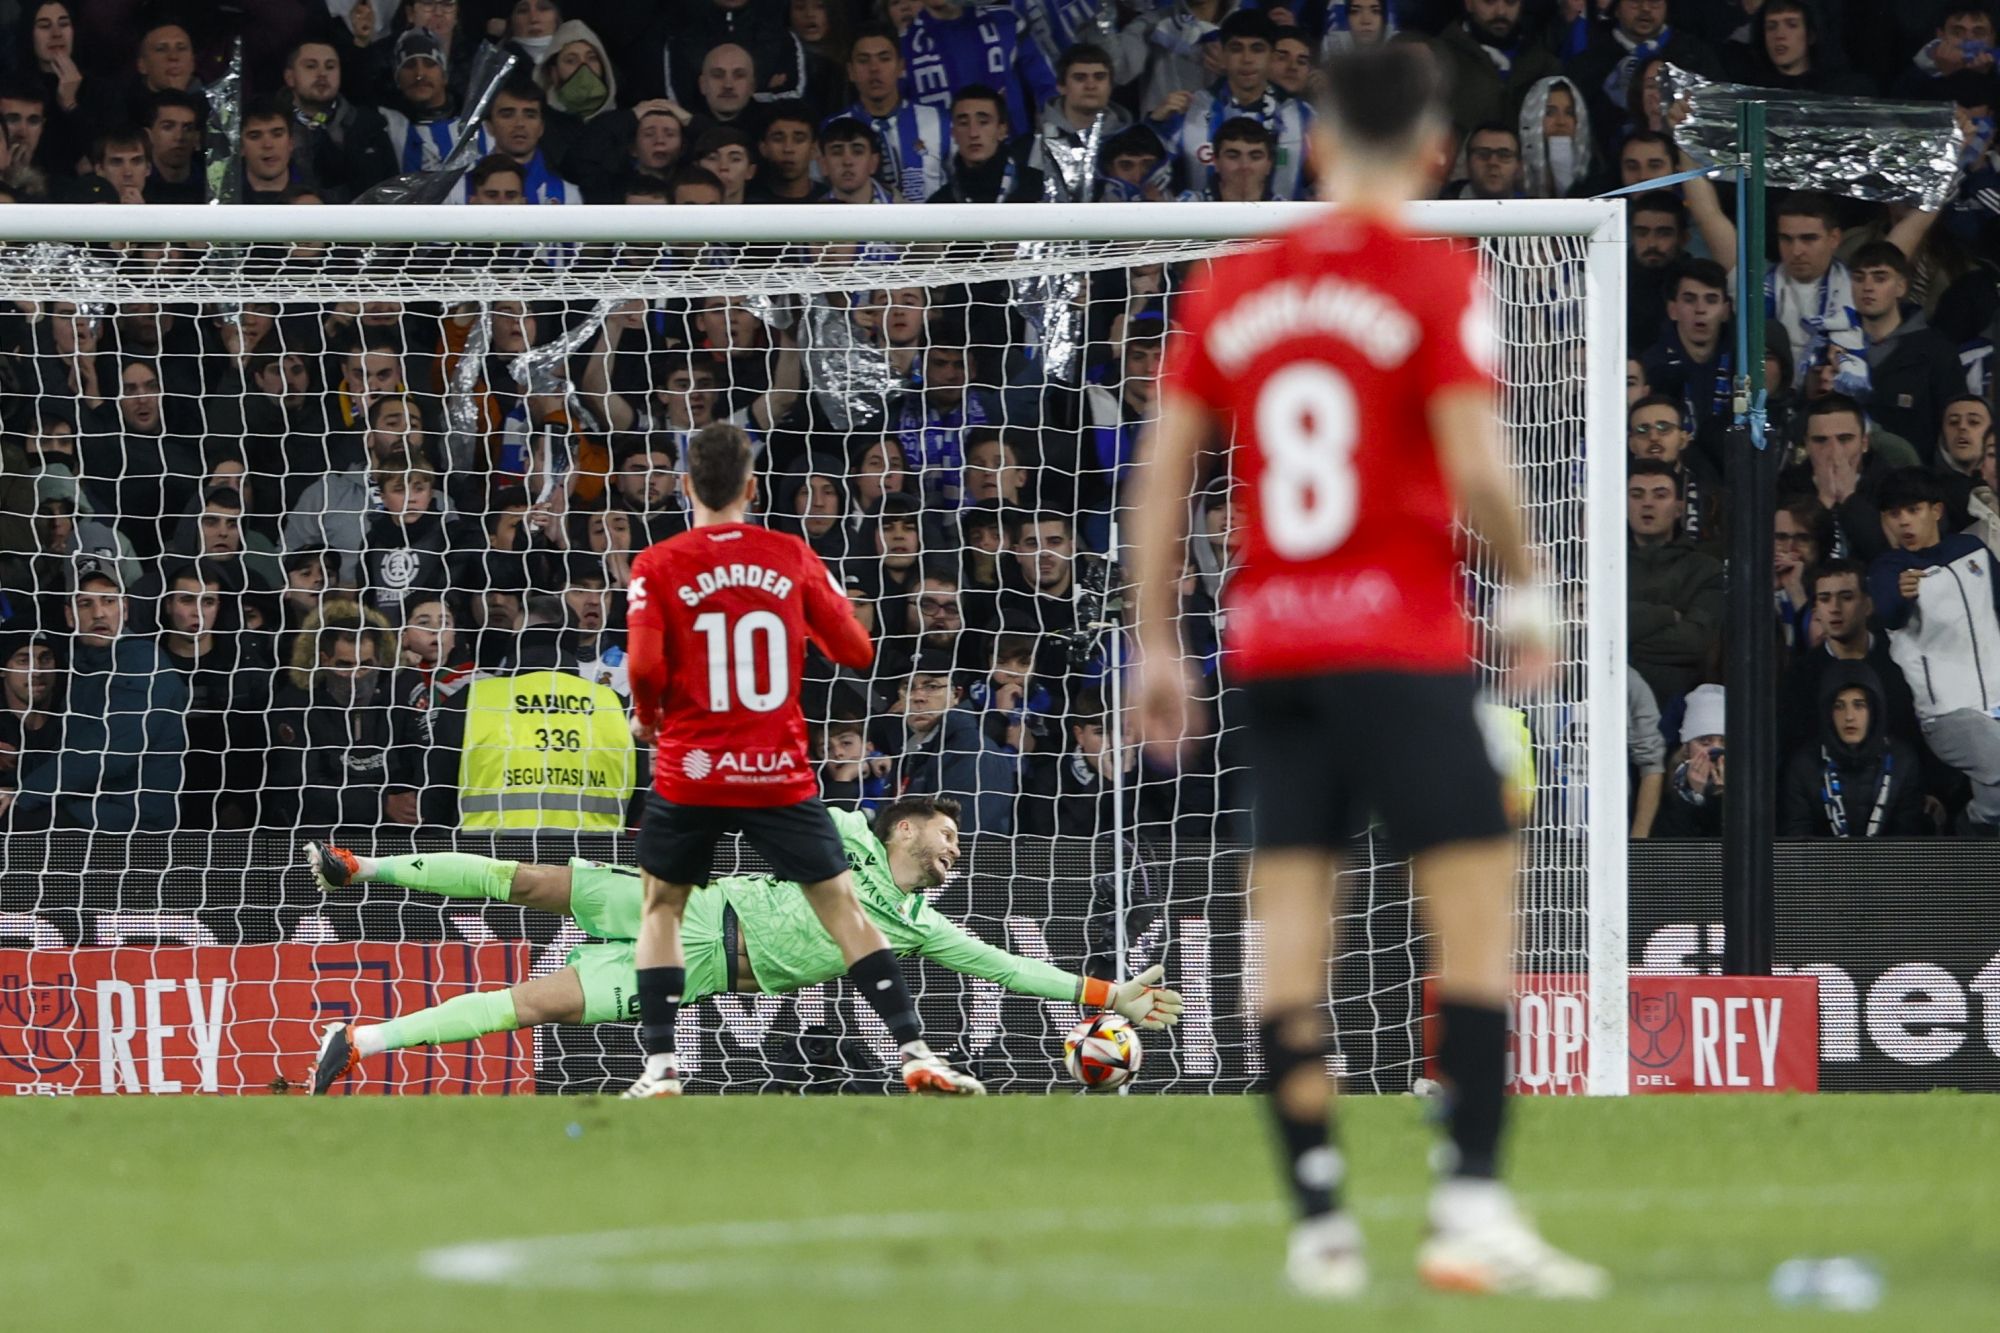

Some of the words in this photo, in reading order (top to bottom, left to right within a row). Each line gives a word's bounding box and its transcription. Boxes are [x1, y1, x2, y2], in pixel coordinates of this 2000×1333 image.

[1255, 360, 1361, 562] 8
[678, 563, 793, 607] S.DARDER
[515, 694, 594, 716] SABICO
[692, 610, 790, 712] 10
[535, 728, 580, 753] 336
[716, 751, 796, 773] ALUA
[15, 1082, 76, 1096] DEL
[96, 977, 228, 1094] REY
[1628, 924, 2000, 1064] fne
[1636, 1074, 1677, 1087] DEL
[1691, 996, 1783, 1087] REY
